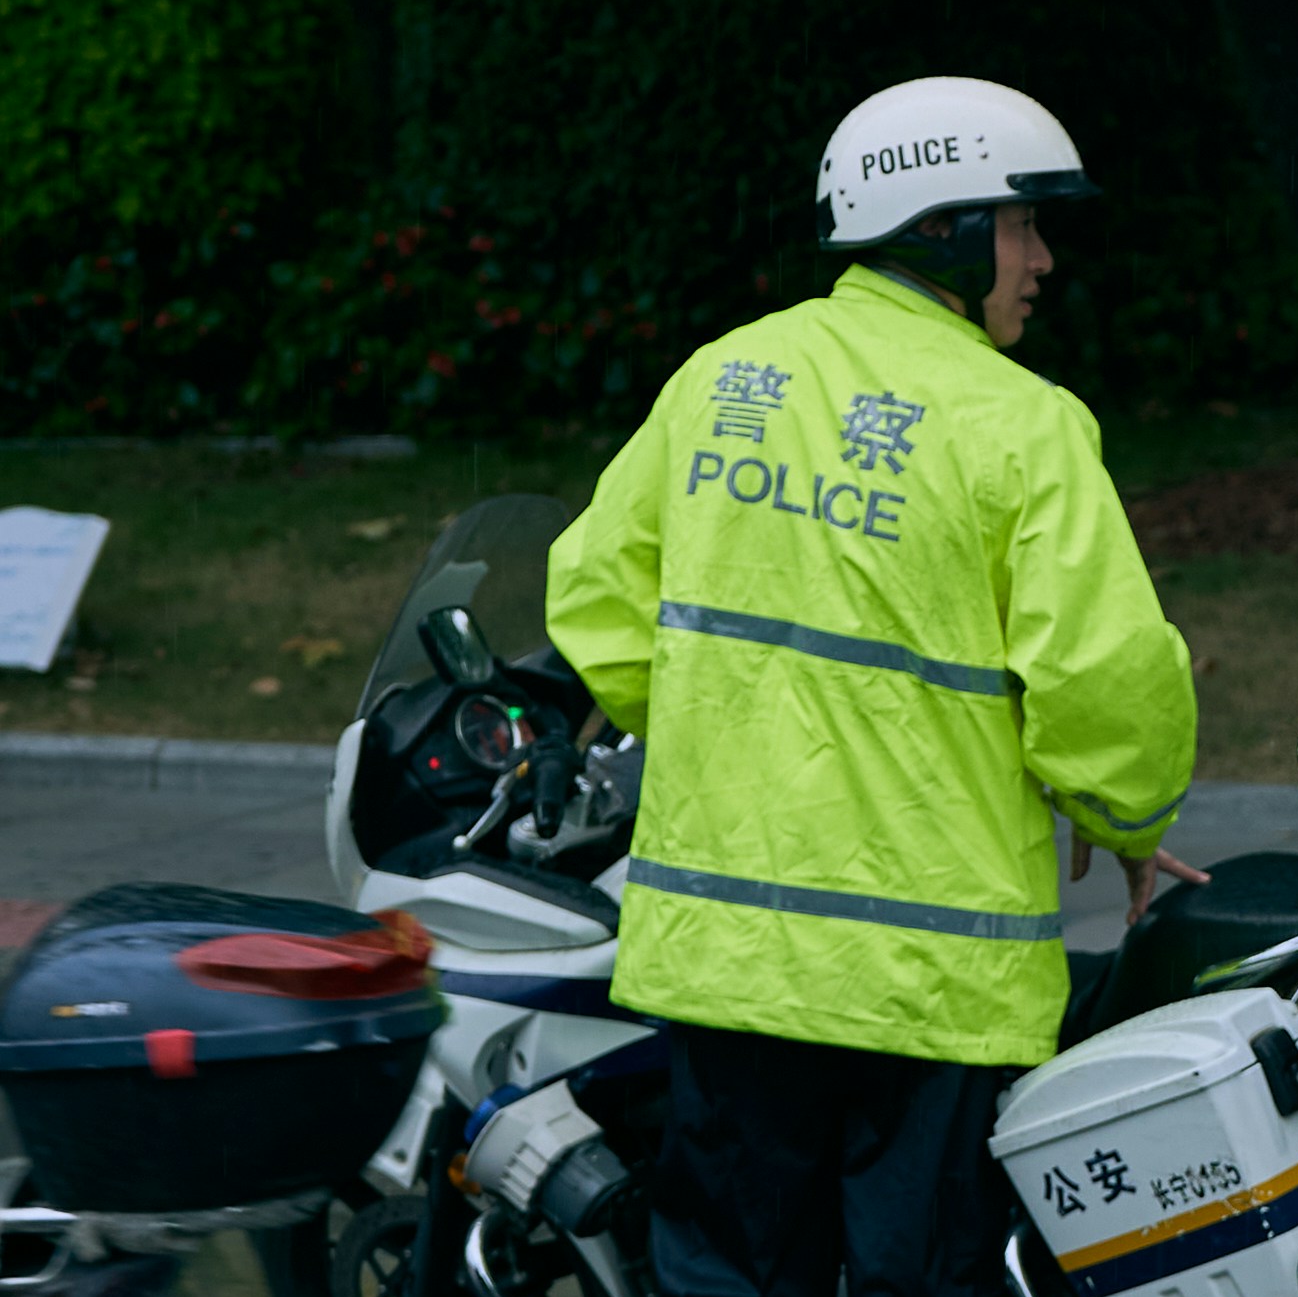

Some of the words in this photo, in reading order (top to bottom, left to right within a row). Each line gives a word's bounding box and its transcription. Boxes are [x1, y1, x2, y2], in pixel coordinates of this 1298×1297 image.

[862, 136, 960, 181] POLICE
[710, 360, 925, 475] 警察
[686, 451, 907, 543] POLICE
[1043, 1147, 1136, 1218] 公安
